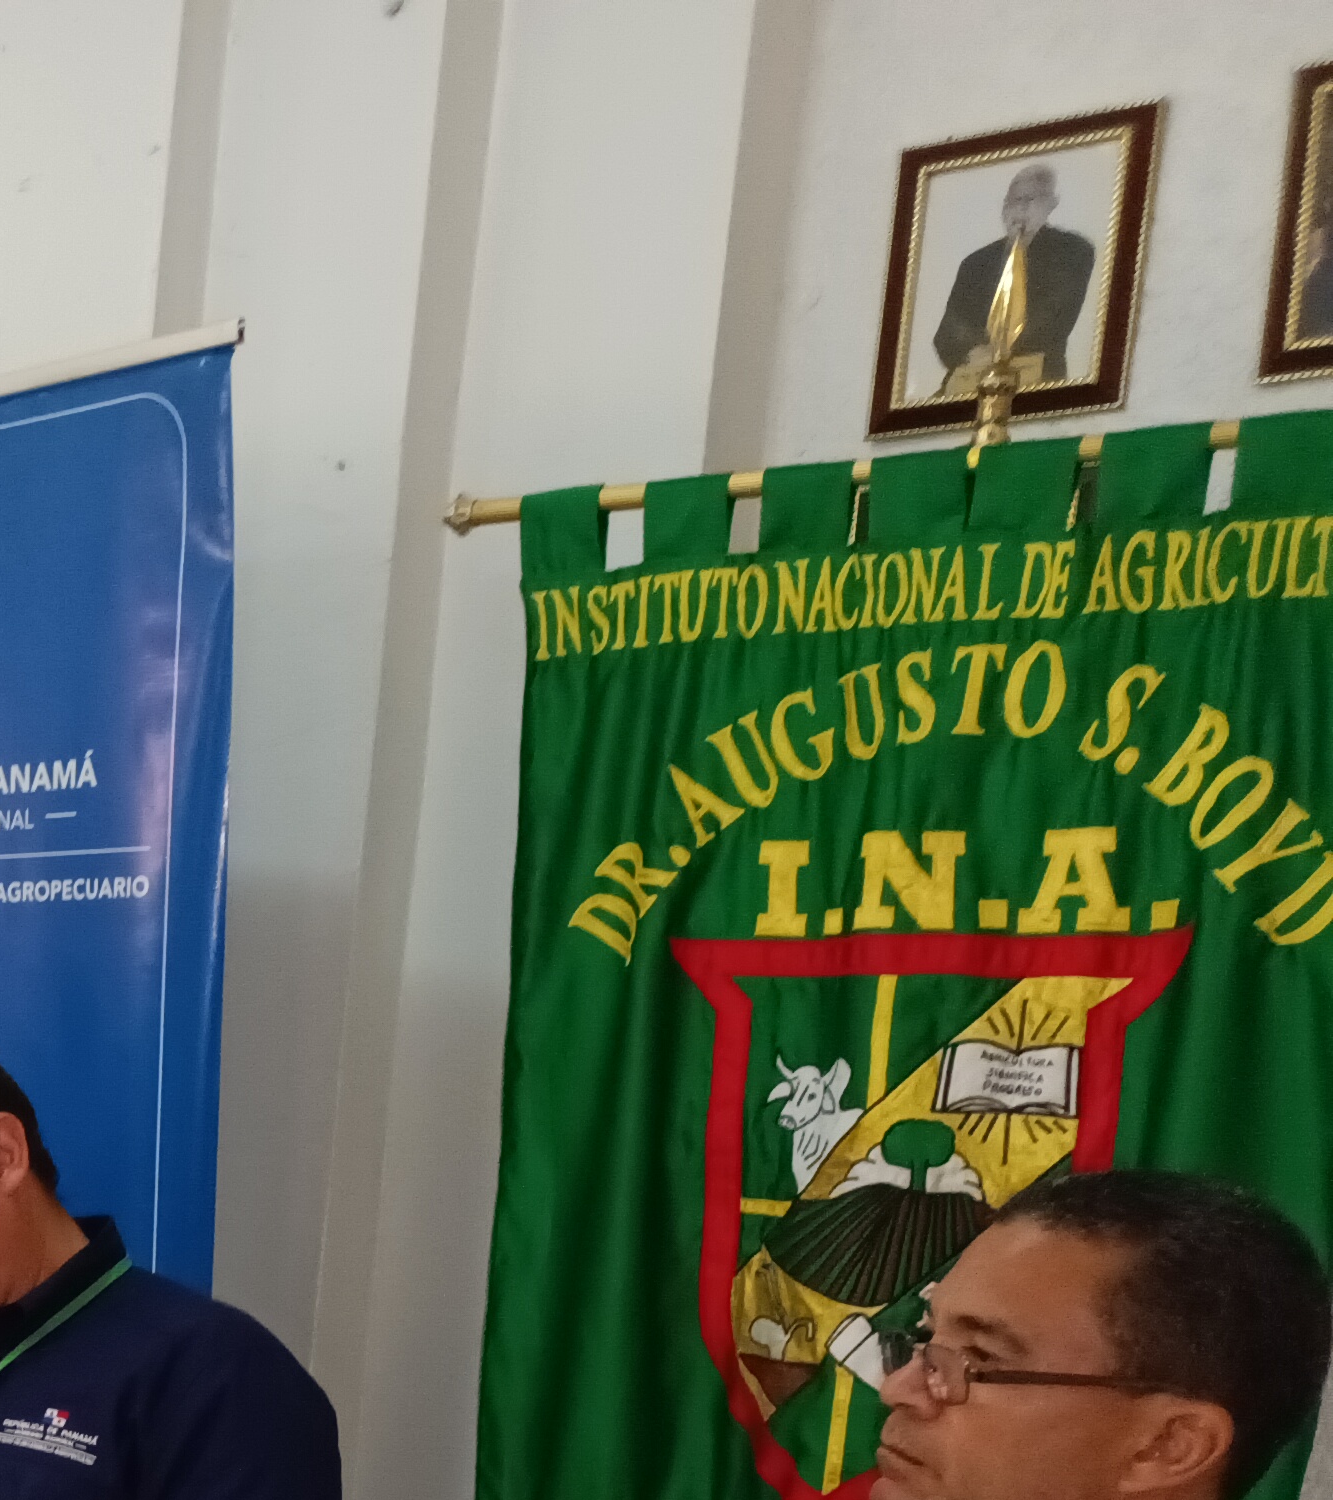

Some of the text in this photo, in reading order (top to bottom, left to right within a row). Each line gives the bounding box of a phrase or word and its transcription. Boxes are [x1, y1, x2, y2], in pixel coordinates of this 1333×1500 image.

[532, 562, 769, 662] INSTITUTO
[771, 541, 1004, 636] NACIONAL
[1009, 537, 1077, 620] DE
[567, 639, 1333, 967] DR. AUGUSTO S. BOYD
[752, 824, 1181, 940] I.N.A.
